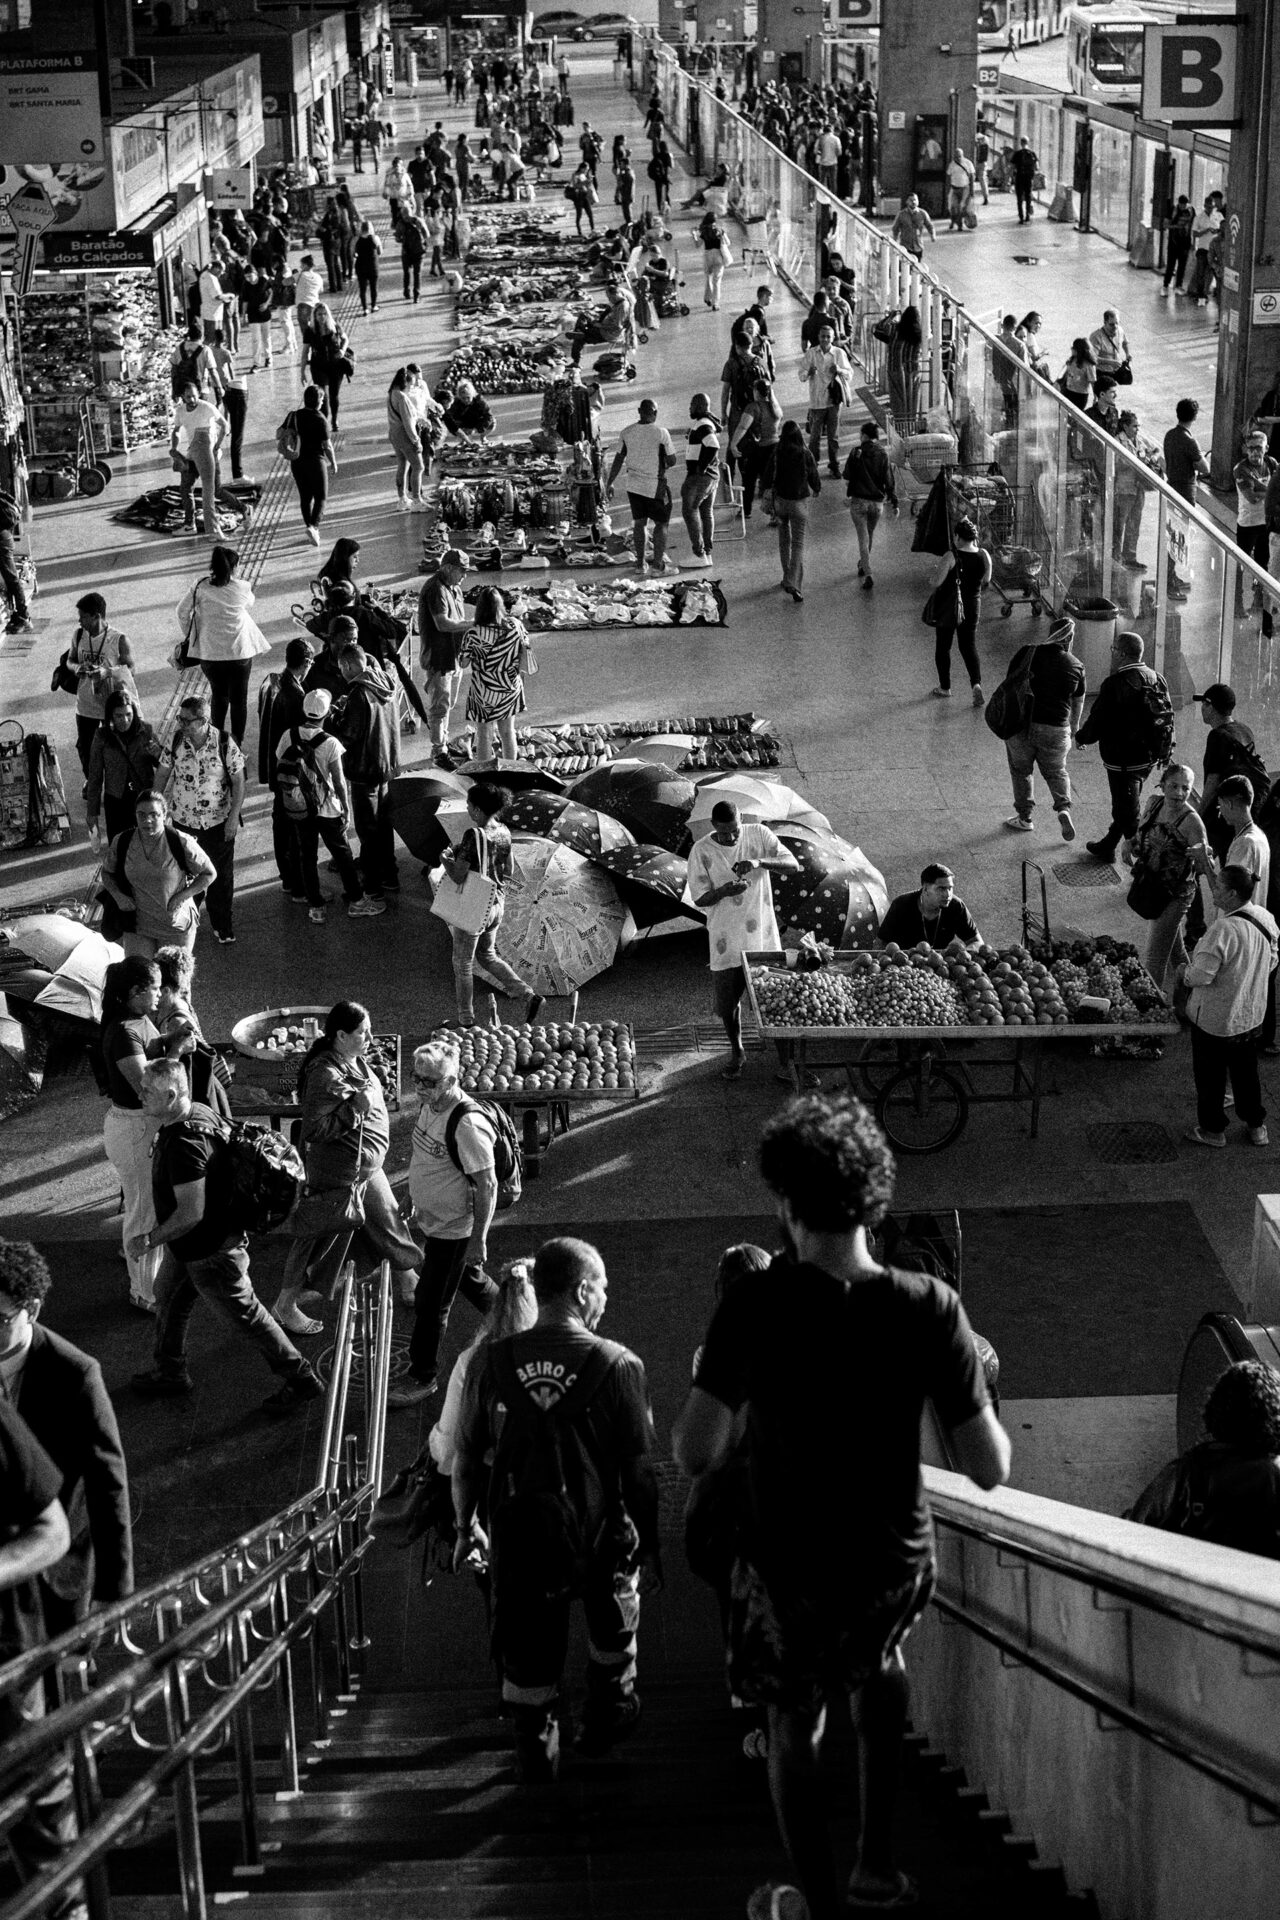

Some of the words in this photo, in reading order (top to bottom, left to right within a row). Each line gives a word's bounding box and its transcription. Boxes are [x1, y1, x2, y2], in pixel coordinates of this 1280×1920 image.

[0, 58, 72, 69] PLATAFORMA
[73, 56, 83, 66] B
[979, 70, 998, 82] B2
[1161, 35, 1224, 108] B
[18, 220, 42, 230] GOLD
[71, 239, 125, 251] Baratão
[53, 253, 80, 263] dos
[82, 250, 144, 264] Calçados
